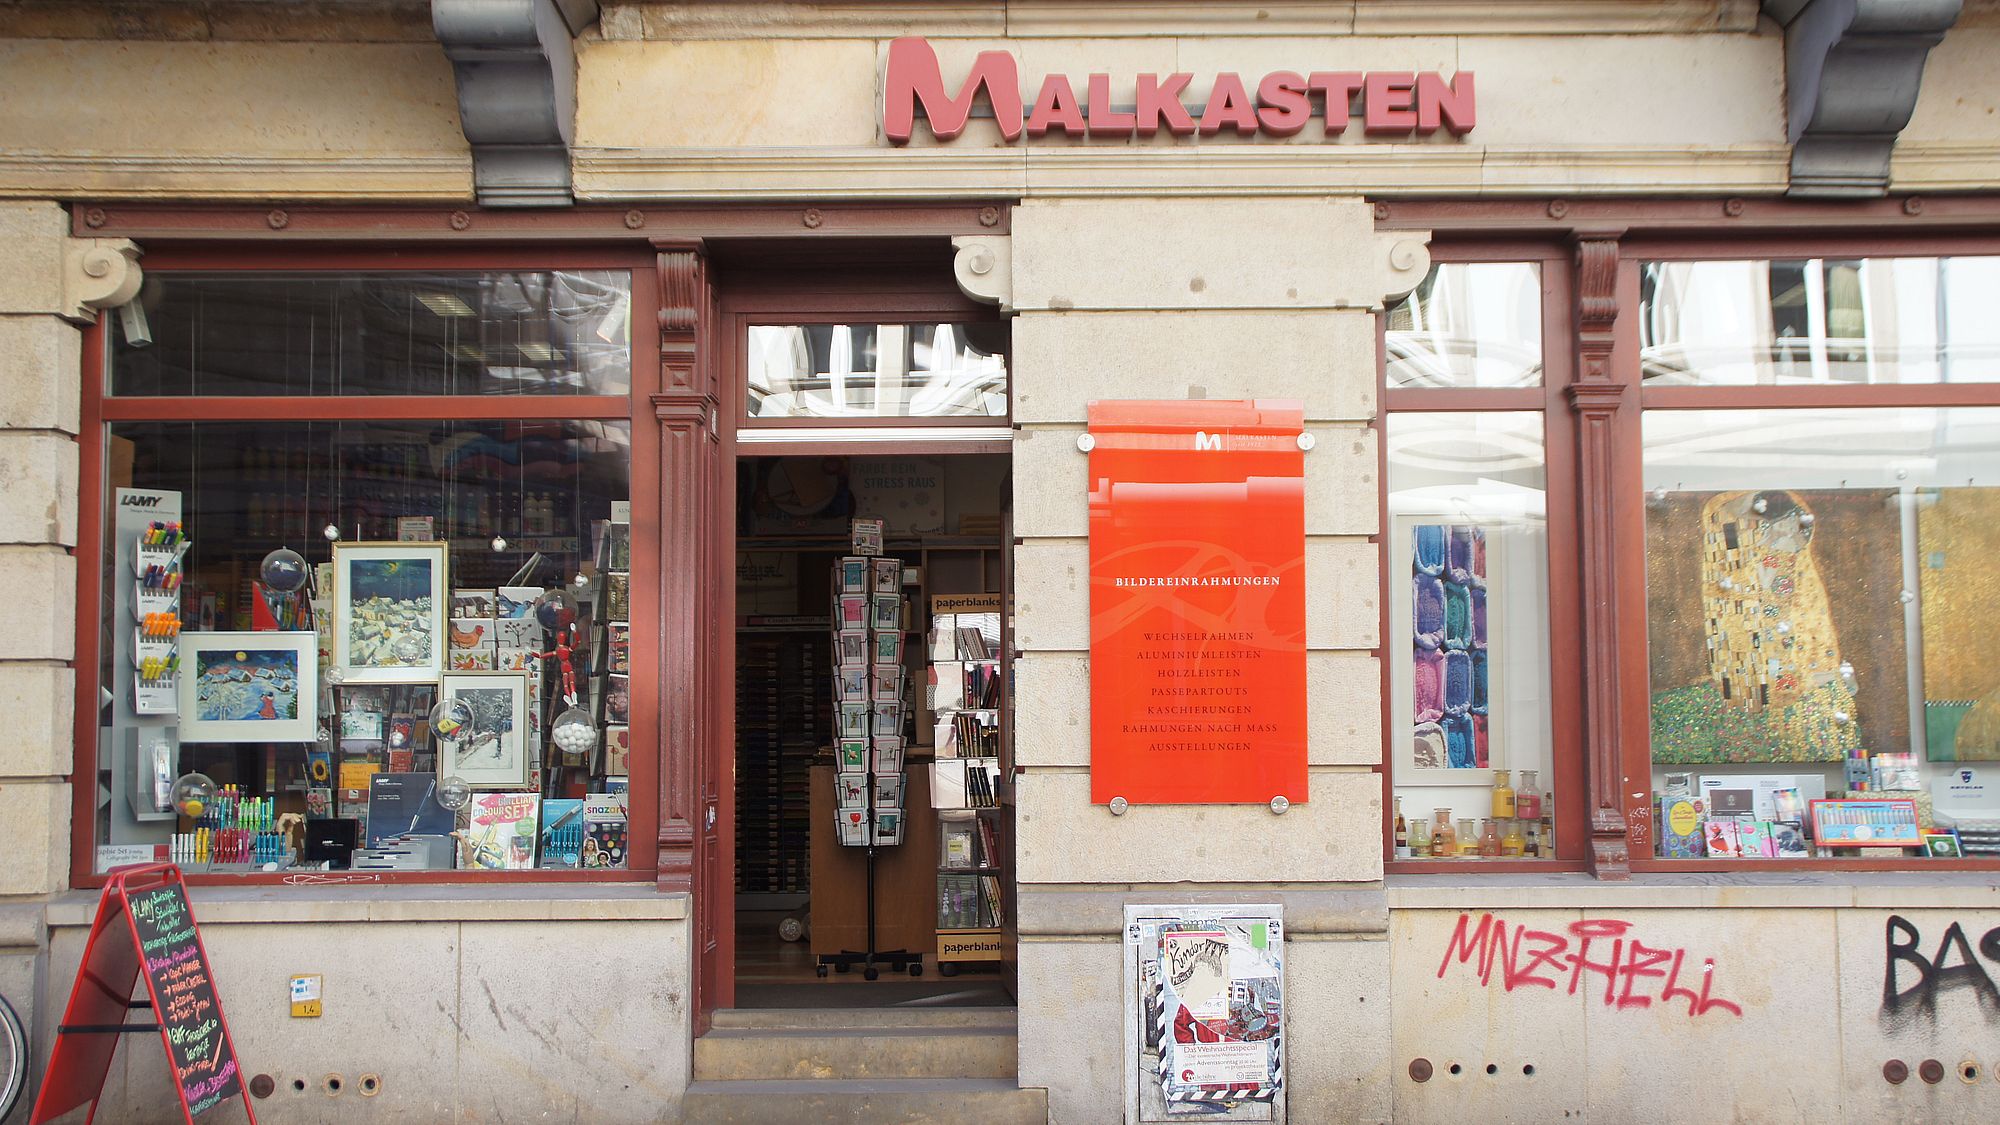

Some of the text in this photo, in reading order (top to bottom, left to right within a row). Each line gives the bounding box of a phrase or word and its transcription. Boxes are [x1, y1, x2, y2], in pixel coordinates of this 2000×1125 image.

[883, 36, 1476, 145] MALKASTEN
[864, 477, 936, 488] STRESS RAUS
[121, 495, 162, 507] LAMY
[1116, 576, 1281, 587] BILDEREINRAHMUNGEN
[1144, 632, 1254, 641] WECHSELRAHMEN
[1137, 650, 1262, 660] ALUMINIUMLEISTEN
[1157, 668, 1241, 678] HOLZLEISTEN
[1151, 687, 1249, 697] PASSEPARTOUTS
[1147, 706, 1253, 715] KASCHIERUNGEN
[1122, 723, 1278, 733] RAHMUNGEN NACH MASS
[1149, 742, 1252, 751] AUSSTELLUNGEN
[505, 803, 530, 819] SET
